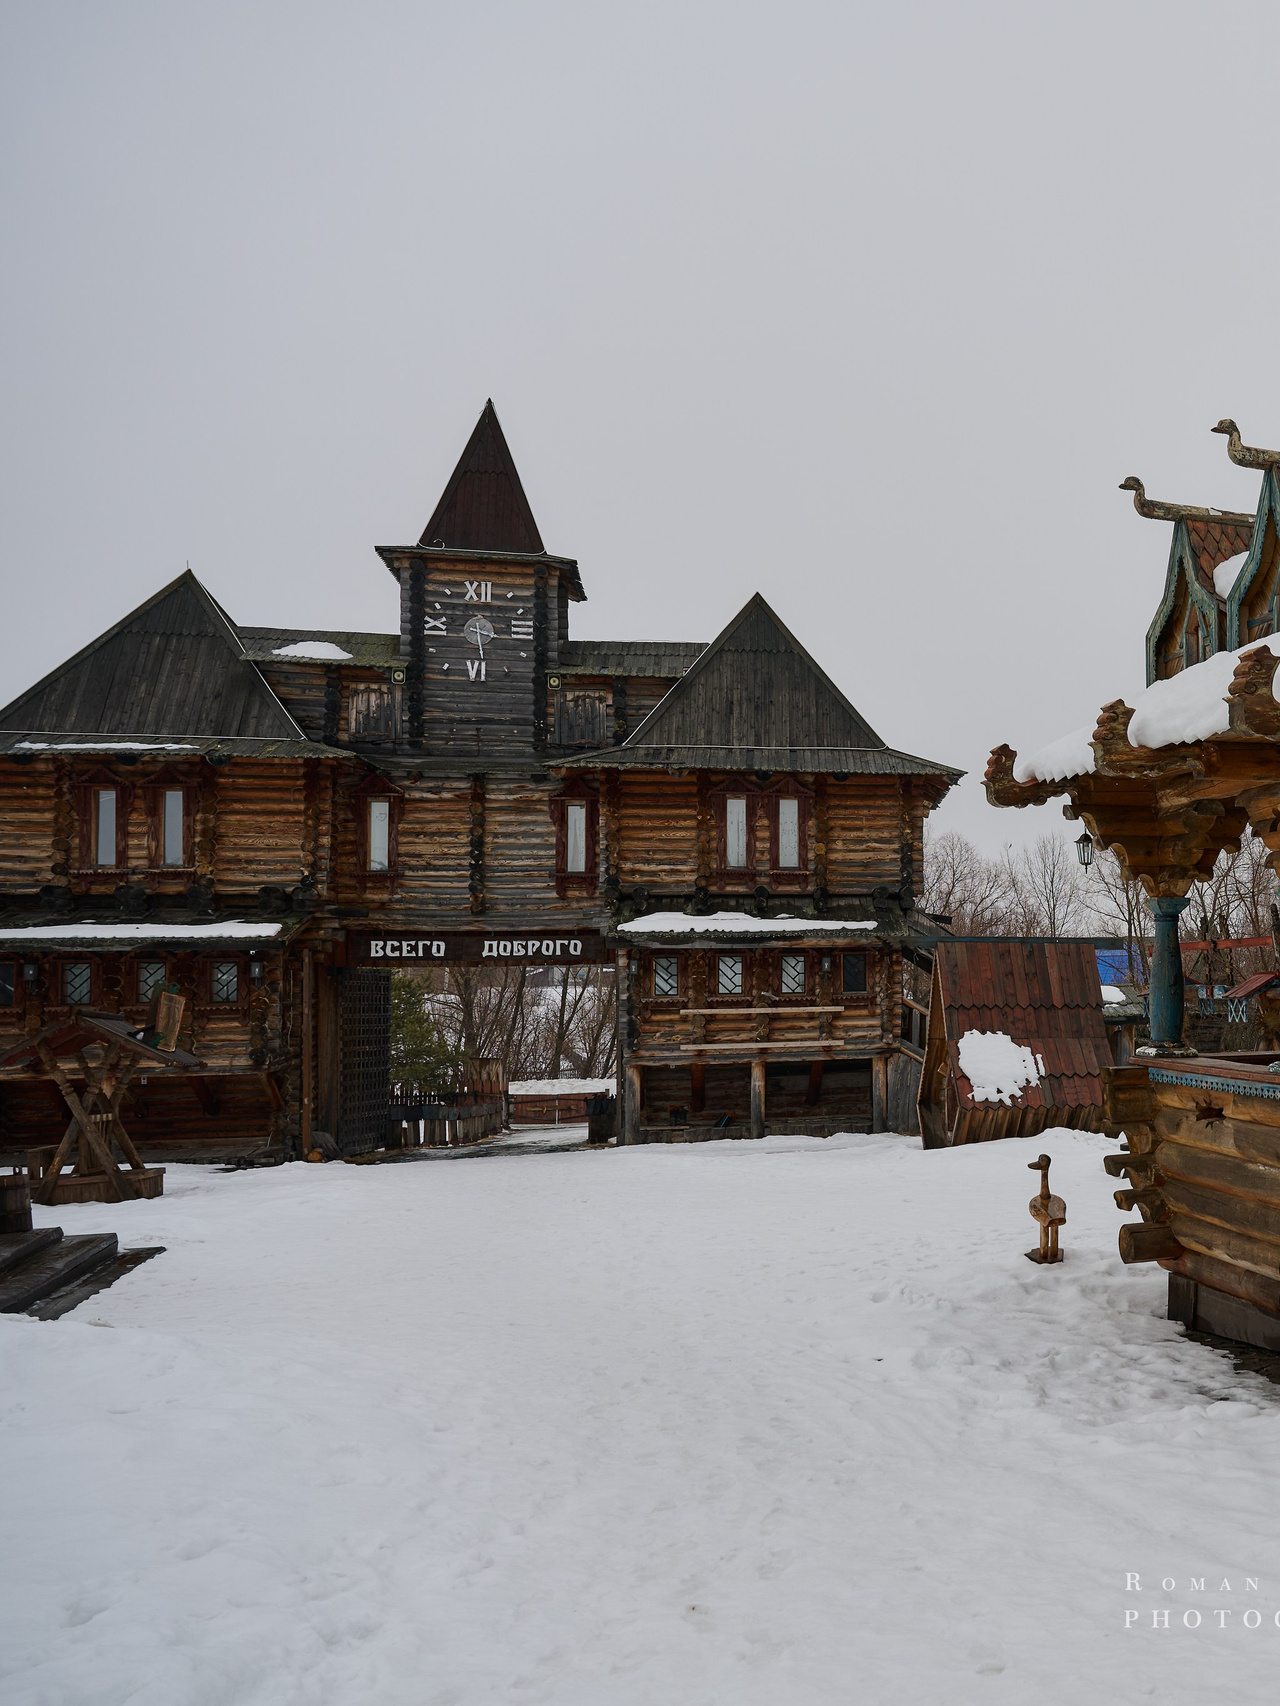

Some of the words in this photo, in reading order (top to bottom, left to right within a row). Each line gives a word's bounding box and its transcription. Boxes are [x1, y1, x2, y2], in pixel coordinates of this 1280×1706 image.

[463, 580, 492, 603] XII
[466, 659, 487, 682] VI
[370, 940, 446, 957] ВСЕГО
[481, 939, 583, 958] ДОБРОГО
